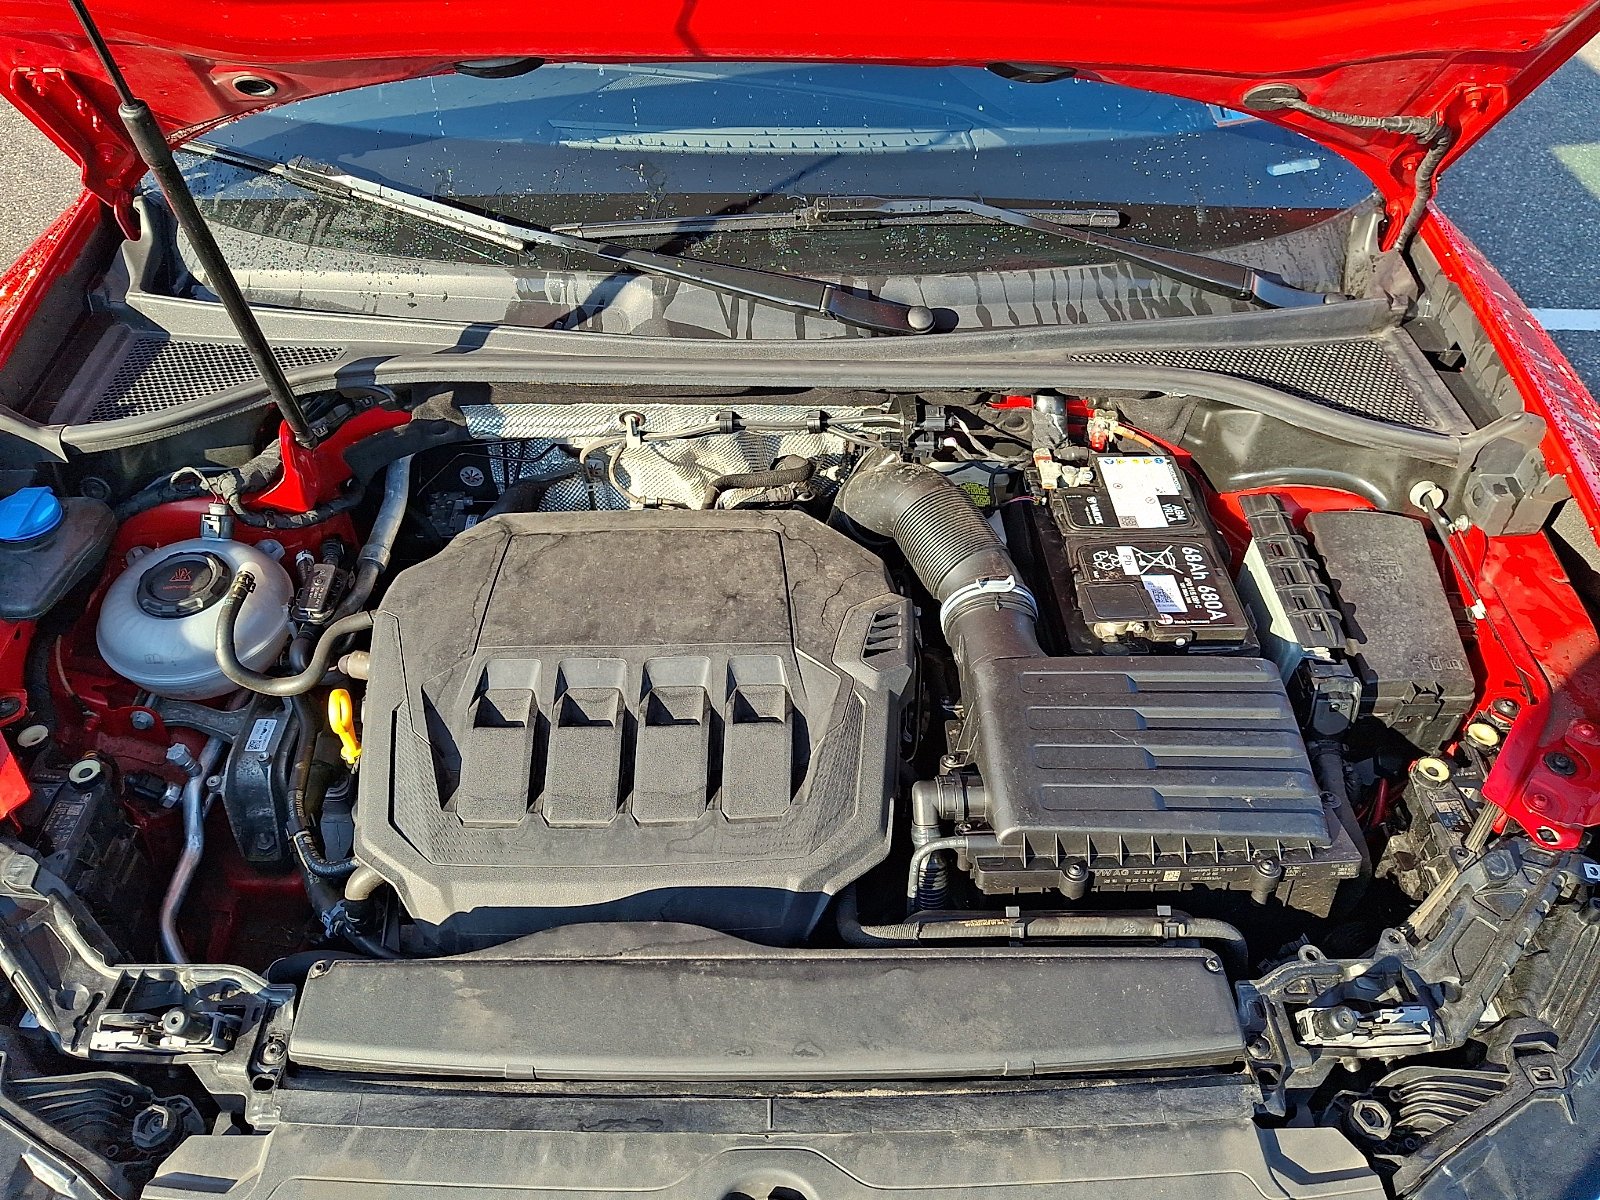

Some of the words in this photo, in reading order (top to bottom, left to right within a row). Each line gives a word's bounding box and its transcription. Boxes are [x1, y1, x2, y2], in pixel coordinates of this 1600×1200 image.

[1161, 503, 1177, 523] VRLA
[1171, 504, 1188, 521] AGM
[1181, 546, 1210, 580] 68Ah
[1197, 585, 1228, 621] 680A
